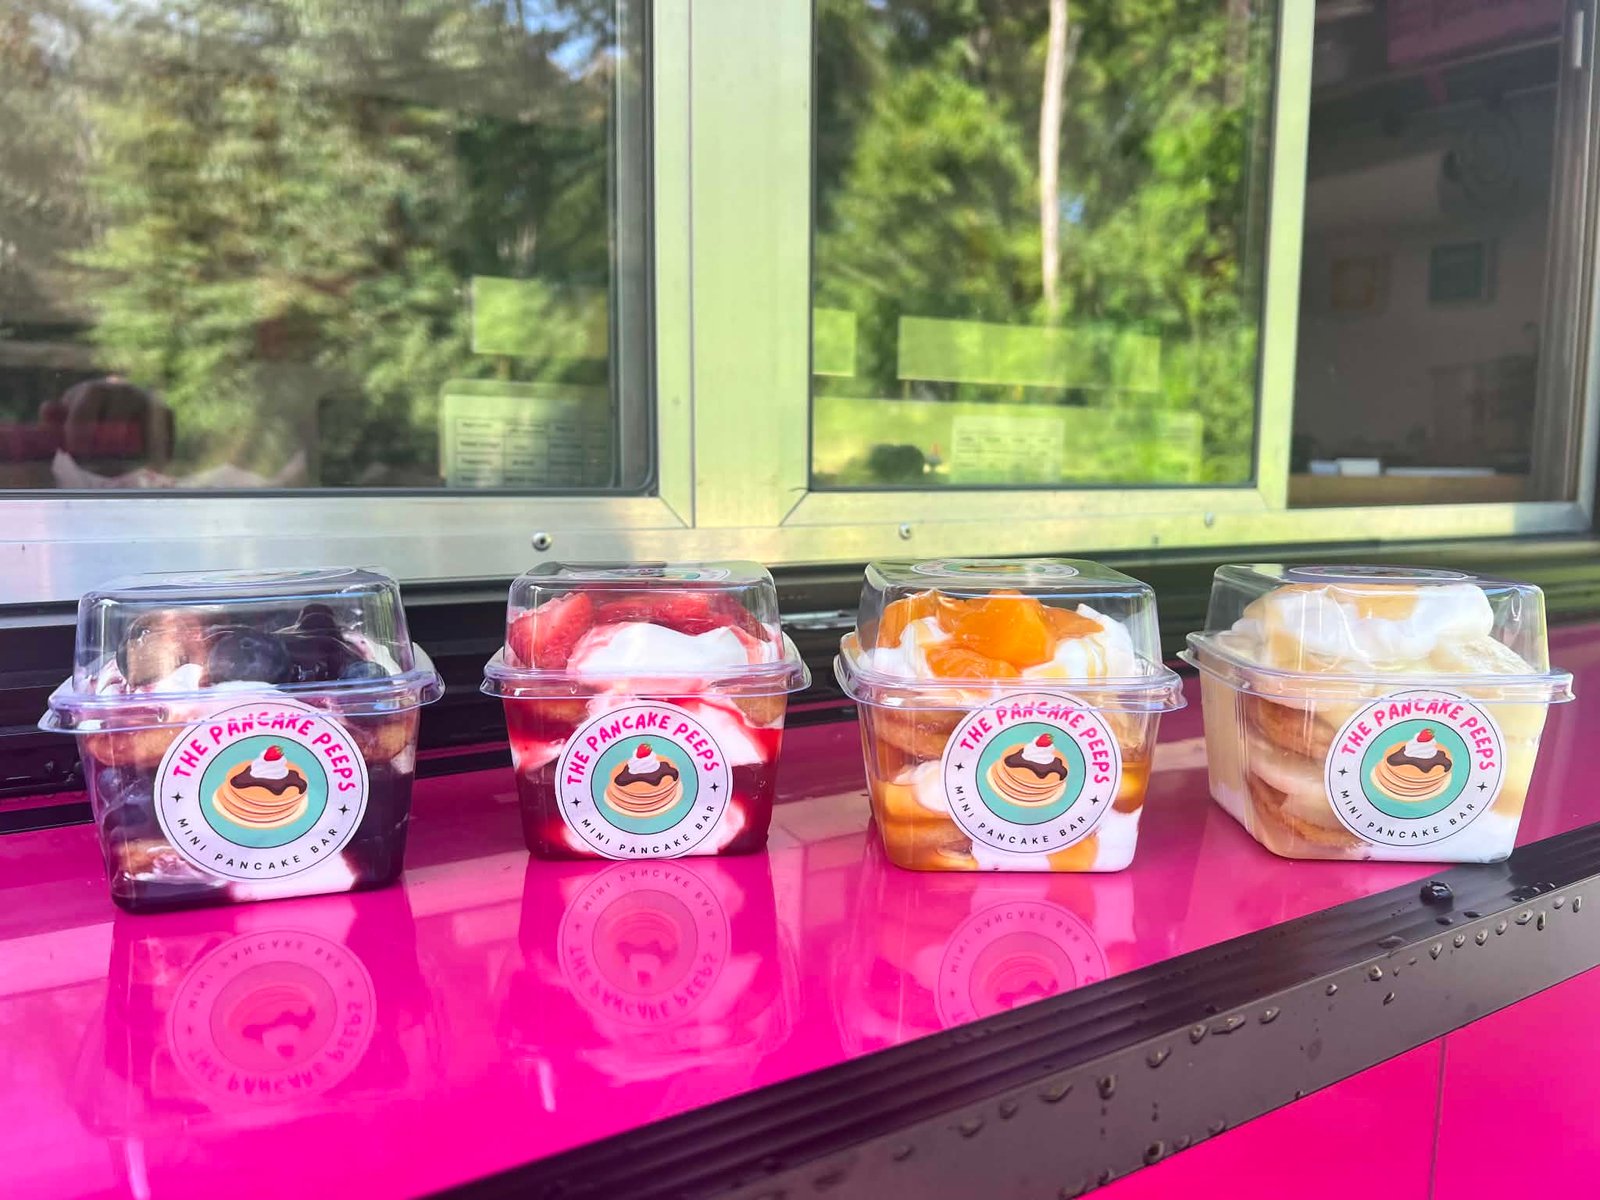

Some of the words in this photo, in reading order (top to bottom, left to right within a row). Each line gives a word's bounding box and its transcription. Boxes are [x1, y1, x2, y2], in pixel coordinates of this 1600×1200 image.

[173, 738, 209, 778] THE
[209, 711, 314, 745] PANCAKE
[311, 732, 356, 792] PEEPS
[567, 750, 590, 785] THE
[586, 712, 671, 752] PANCAKE
[672, 723, 720, 772] PEEPS
[960, 717, 993, 751] THE
[996, 701, 1085, 729] PANCAKE
[1079, 727, 1110, 785] PEEPS
[1341, 721, 1372, 756] THE
[1373, 699, 1464, 727] PANCAKE
[1459, 717, 1495, 771] PEEPS
[177, 818, 207, 851] MINI
[214, 853, 301, 870] PANCAKE
[310, 828, 338, 854] BAR
[581, 818, 611, 845] MINI
[619, 834, 690, 854] PANCAKE
[695, 805, 714, 830] BAR
[954, 785, 974, 818] MINI
[978, 822, 1049, 845] PANCAKE
[1059, 816, 1086, 837] BAR
[1340, 790, 1363, 820] MINI
[1367, 821, 1440, 839] PANCAKE
[1449, 803, 1475, 826] BAR
